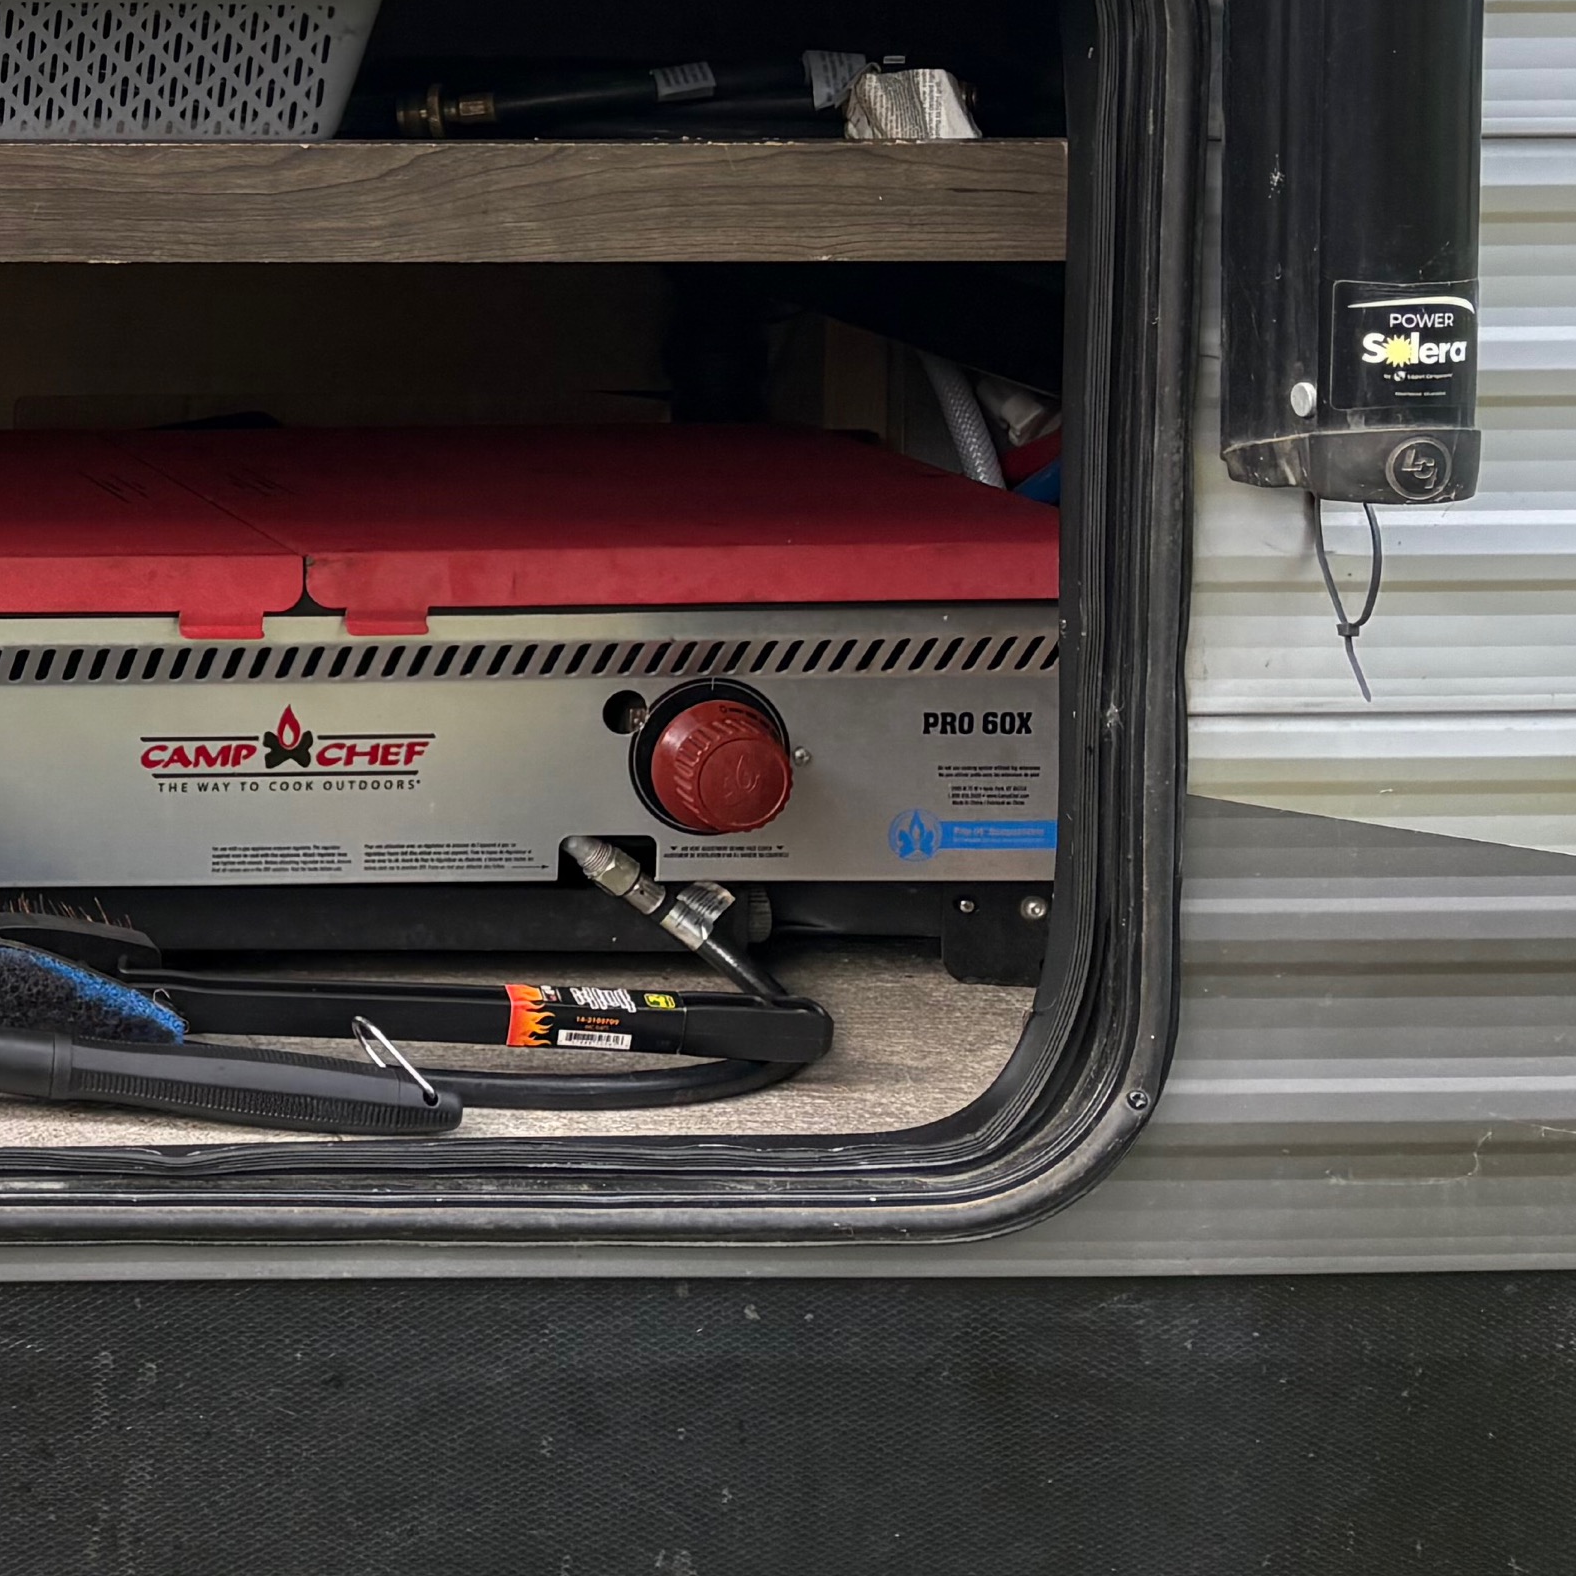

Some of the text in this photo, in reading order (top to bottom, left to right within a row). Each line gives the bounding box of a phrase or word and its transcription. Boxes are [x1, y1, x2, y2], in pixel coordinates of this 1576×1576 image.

[1390, 313, 1454, 328] POWER
[1362, 332, 1467, 367] Solera
[923, 712, 1033, 735] PRO 60X
[140, 741, 429, 769] CAMP CHEF
[158, 779, 415, 793] THE WAY TO COOK OUTDOORS
